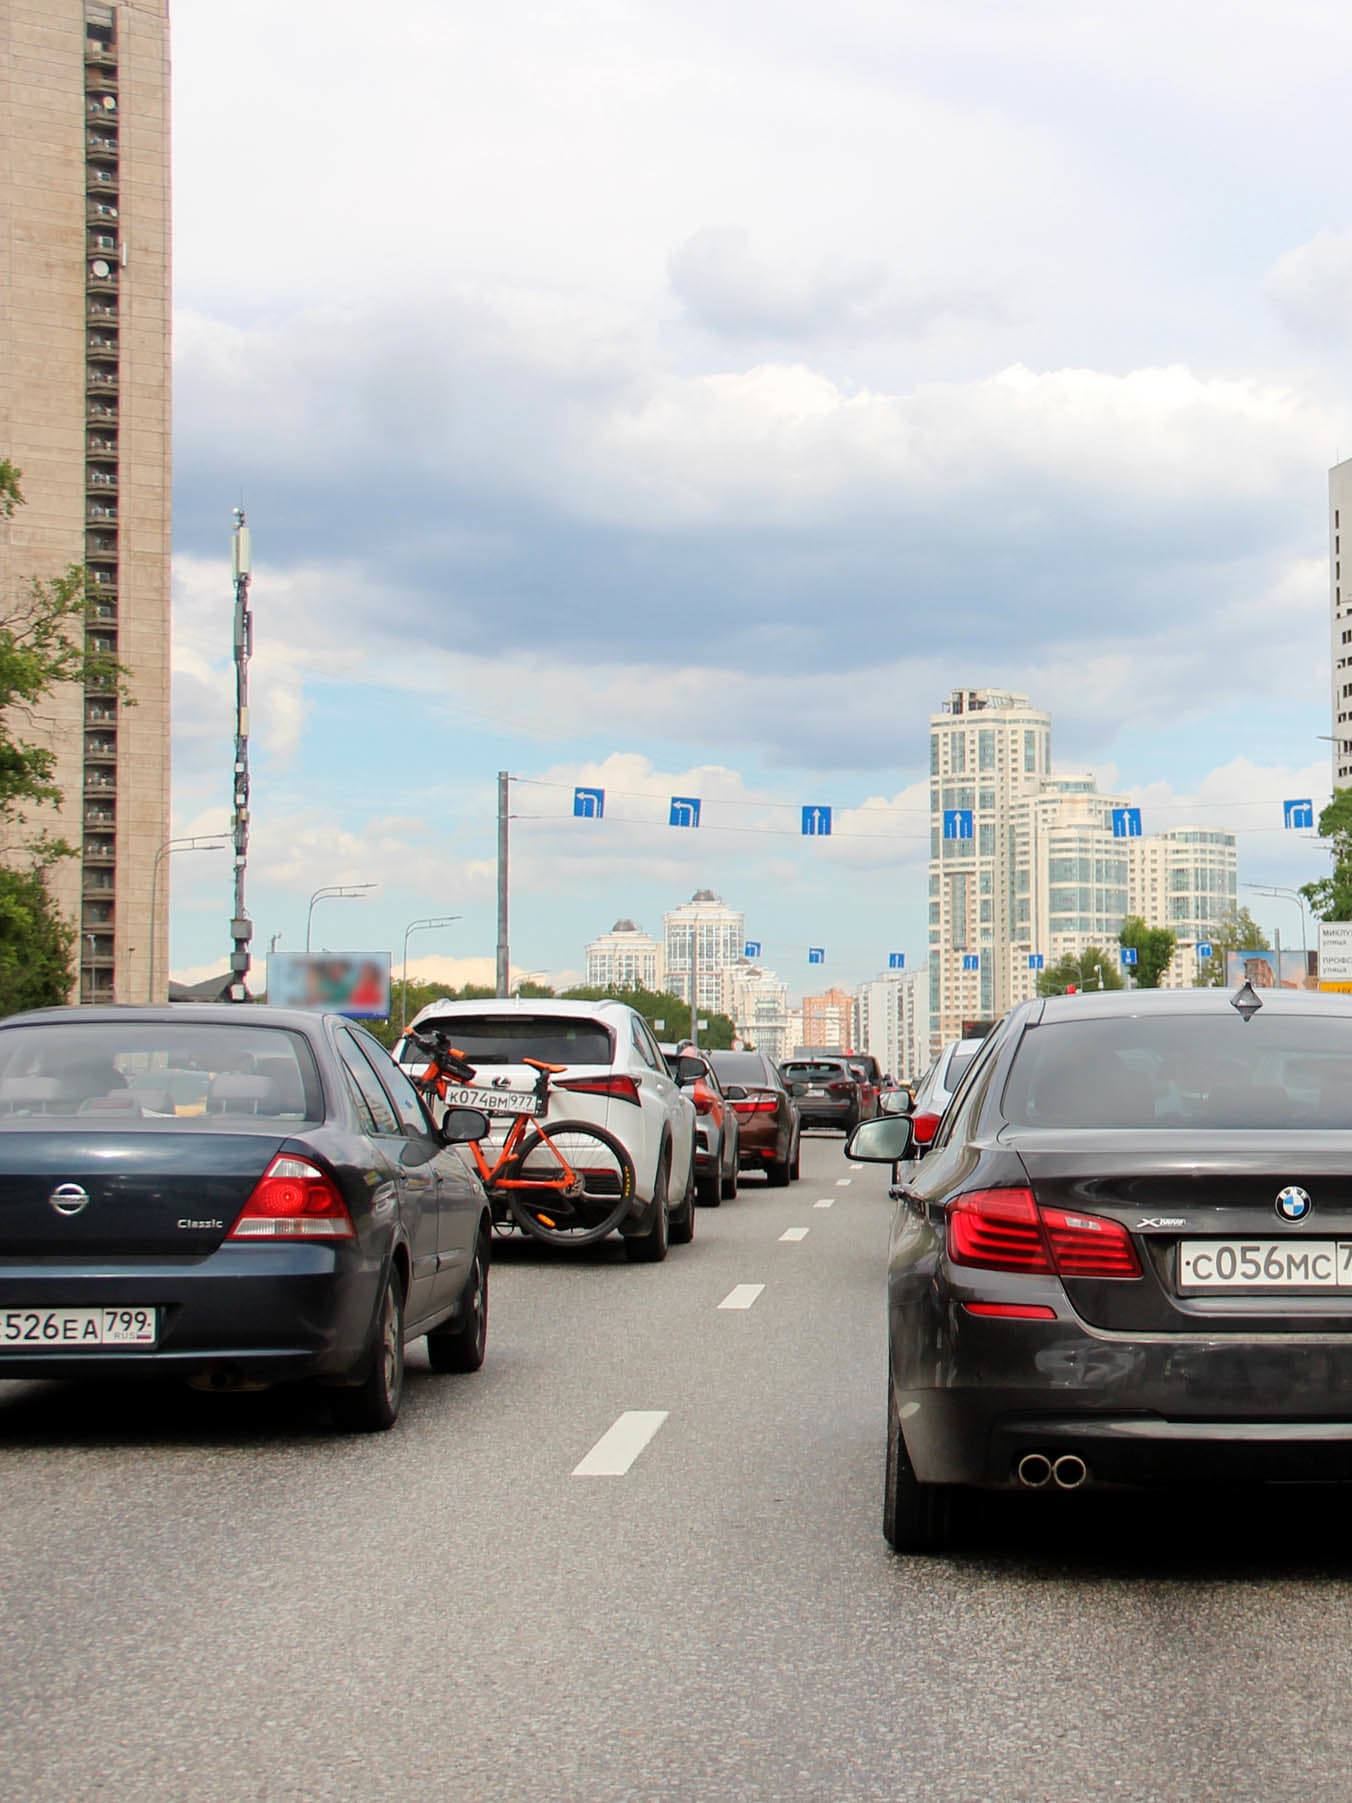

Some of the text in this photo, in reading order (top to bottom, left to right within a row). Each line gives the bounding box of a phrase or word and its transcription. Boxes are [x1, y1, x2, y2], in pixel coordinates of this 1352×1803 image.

[510, 1094, 533, 1108] 977
[177, 1217, 224, 1229] Classic
[1192, 1246, 1332, 1281] С056МС
[0, 1311, 148, 1340] 526ЕА 799
[114, 1331, 136, 1339] RUS
